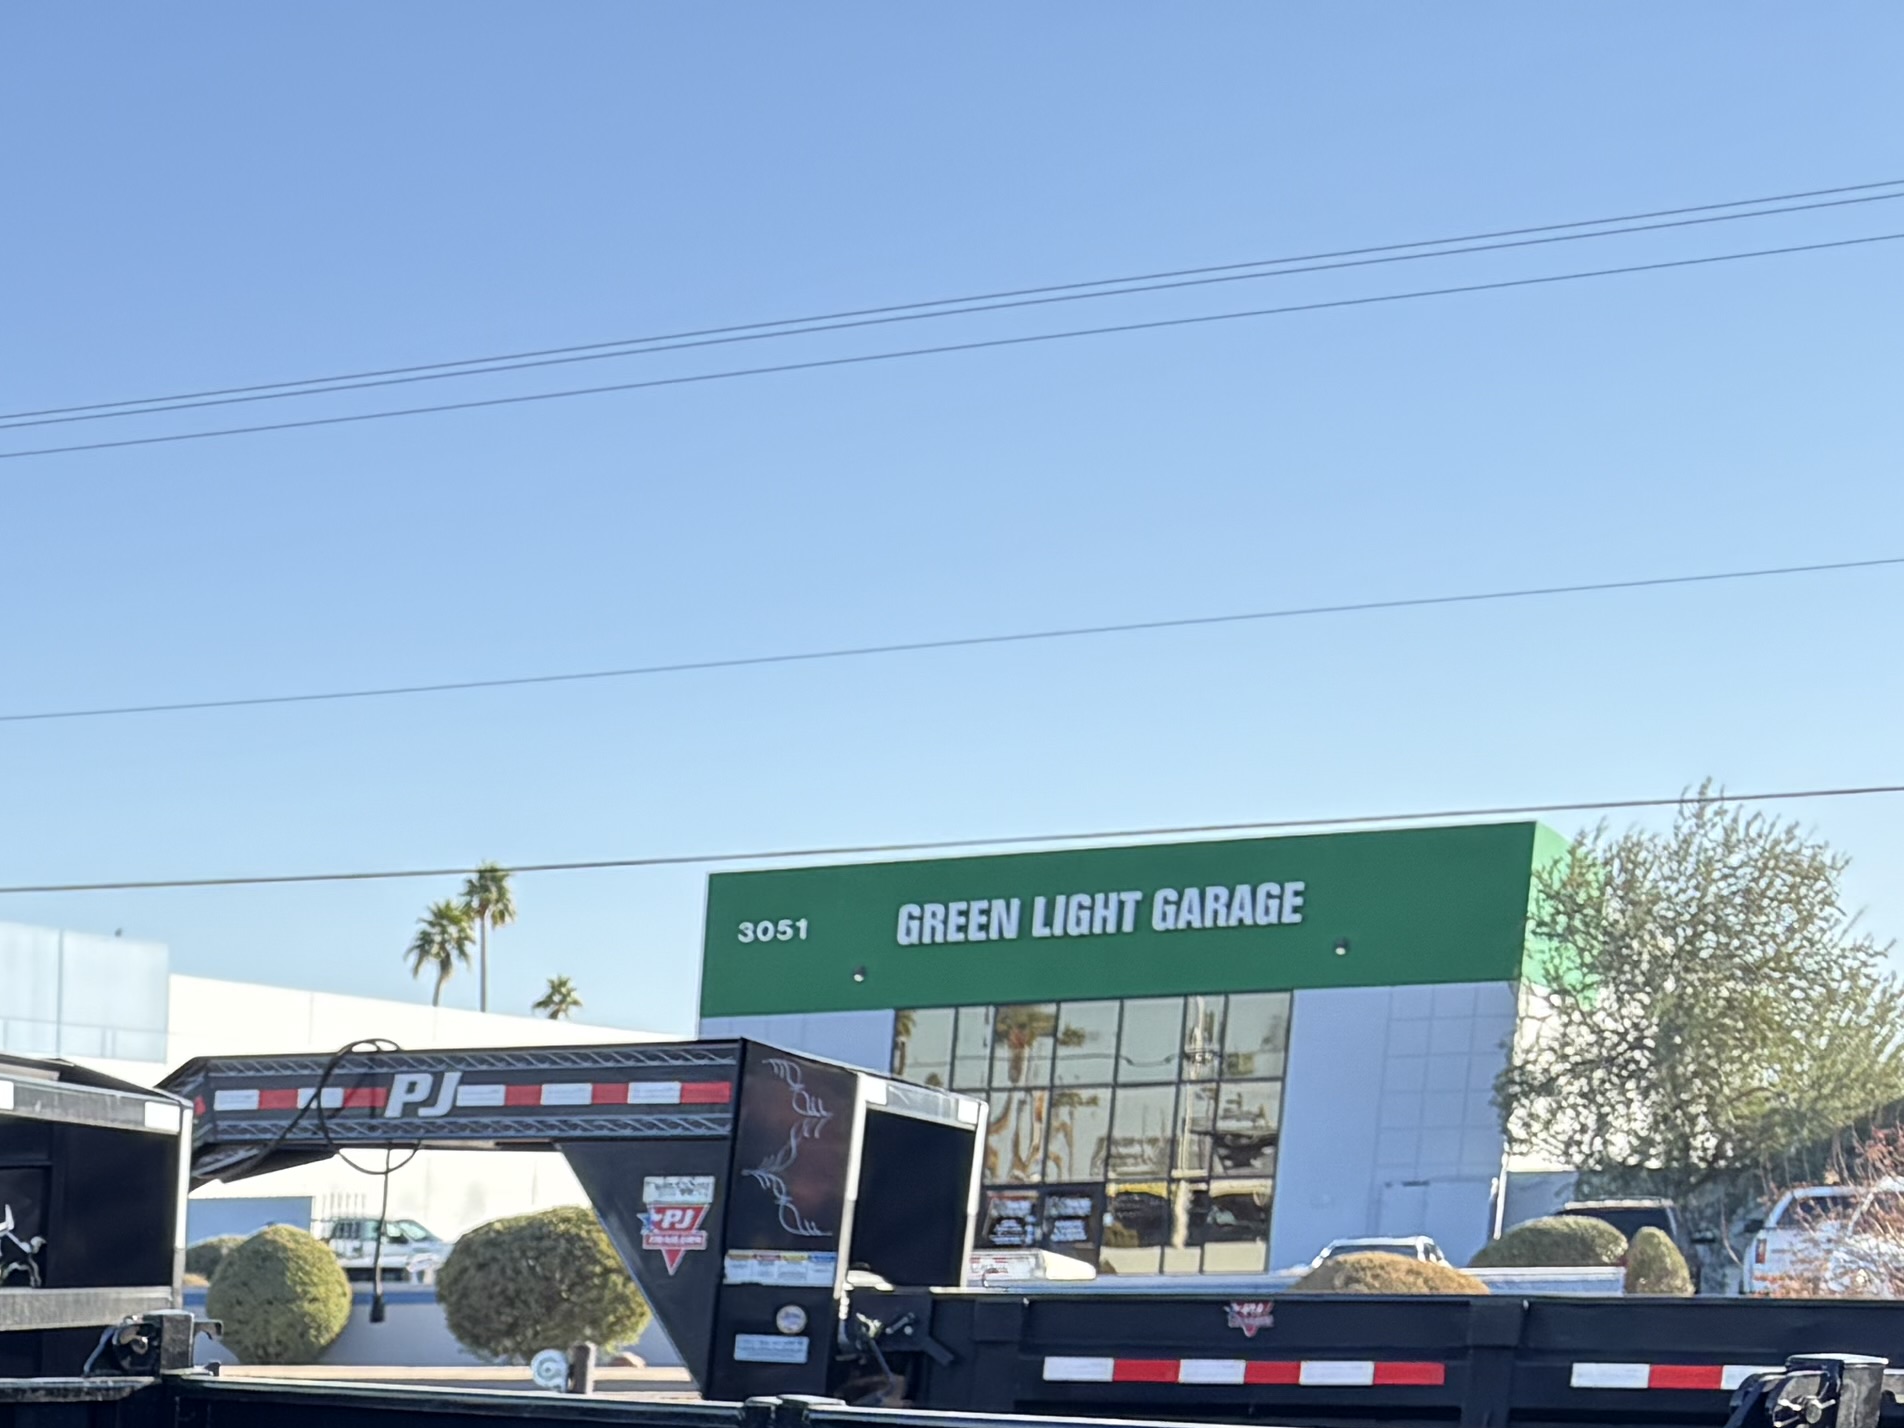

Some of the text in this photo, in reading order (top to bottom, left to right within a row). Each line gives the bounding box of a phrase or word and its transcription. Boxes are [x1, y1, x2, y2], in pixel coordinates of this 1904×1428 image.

[737, 881, 1306, 945] 3051 GREEN LIGHT GARAGE
[384, 1071, 462, 1118] PJ
